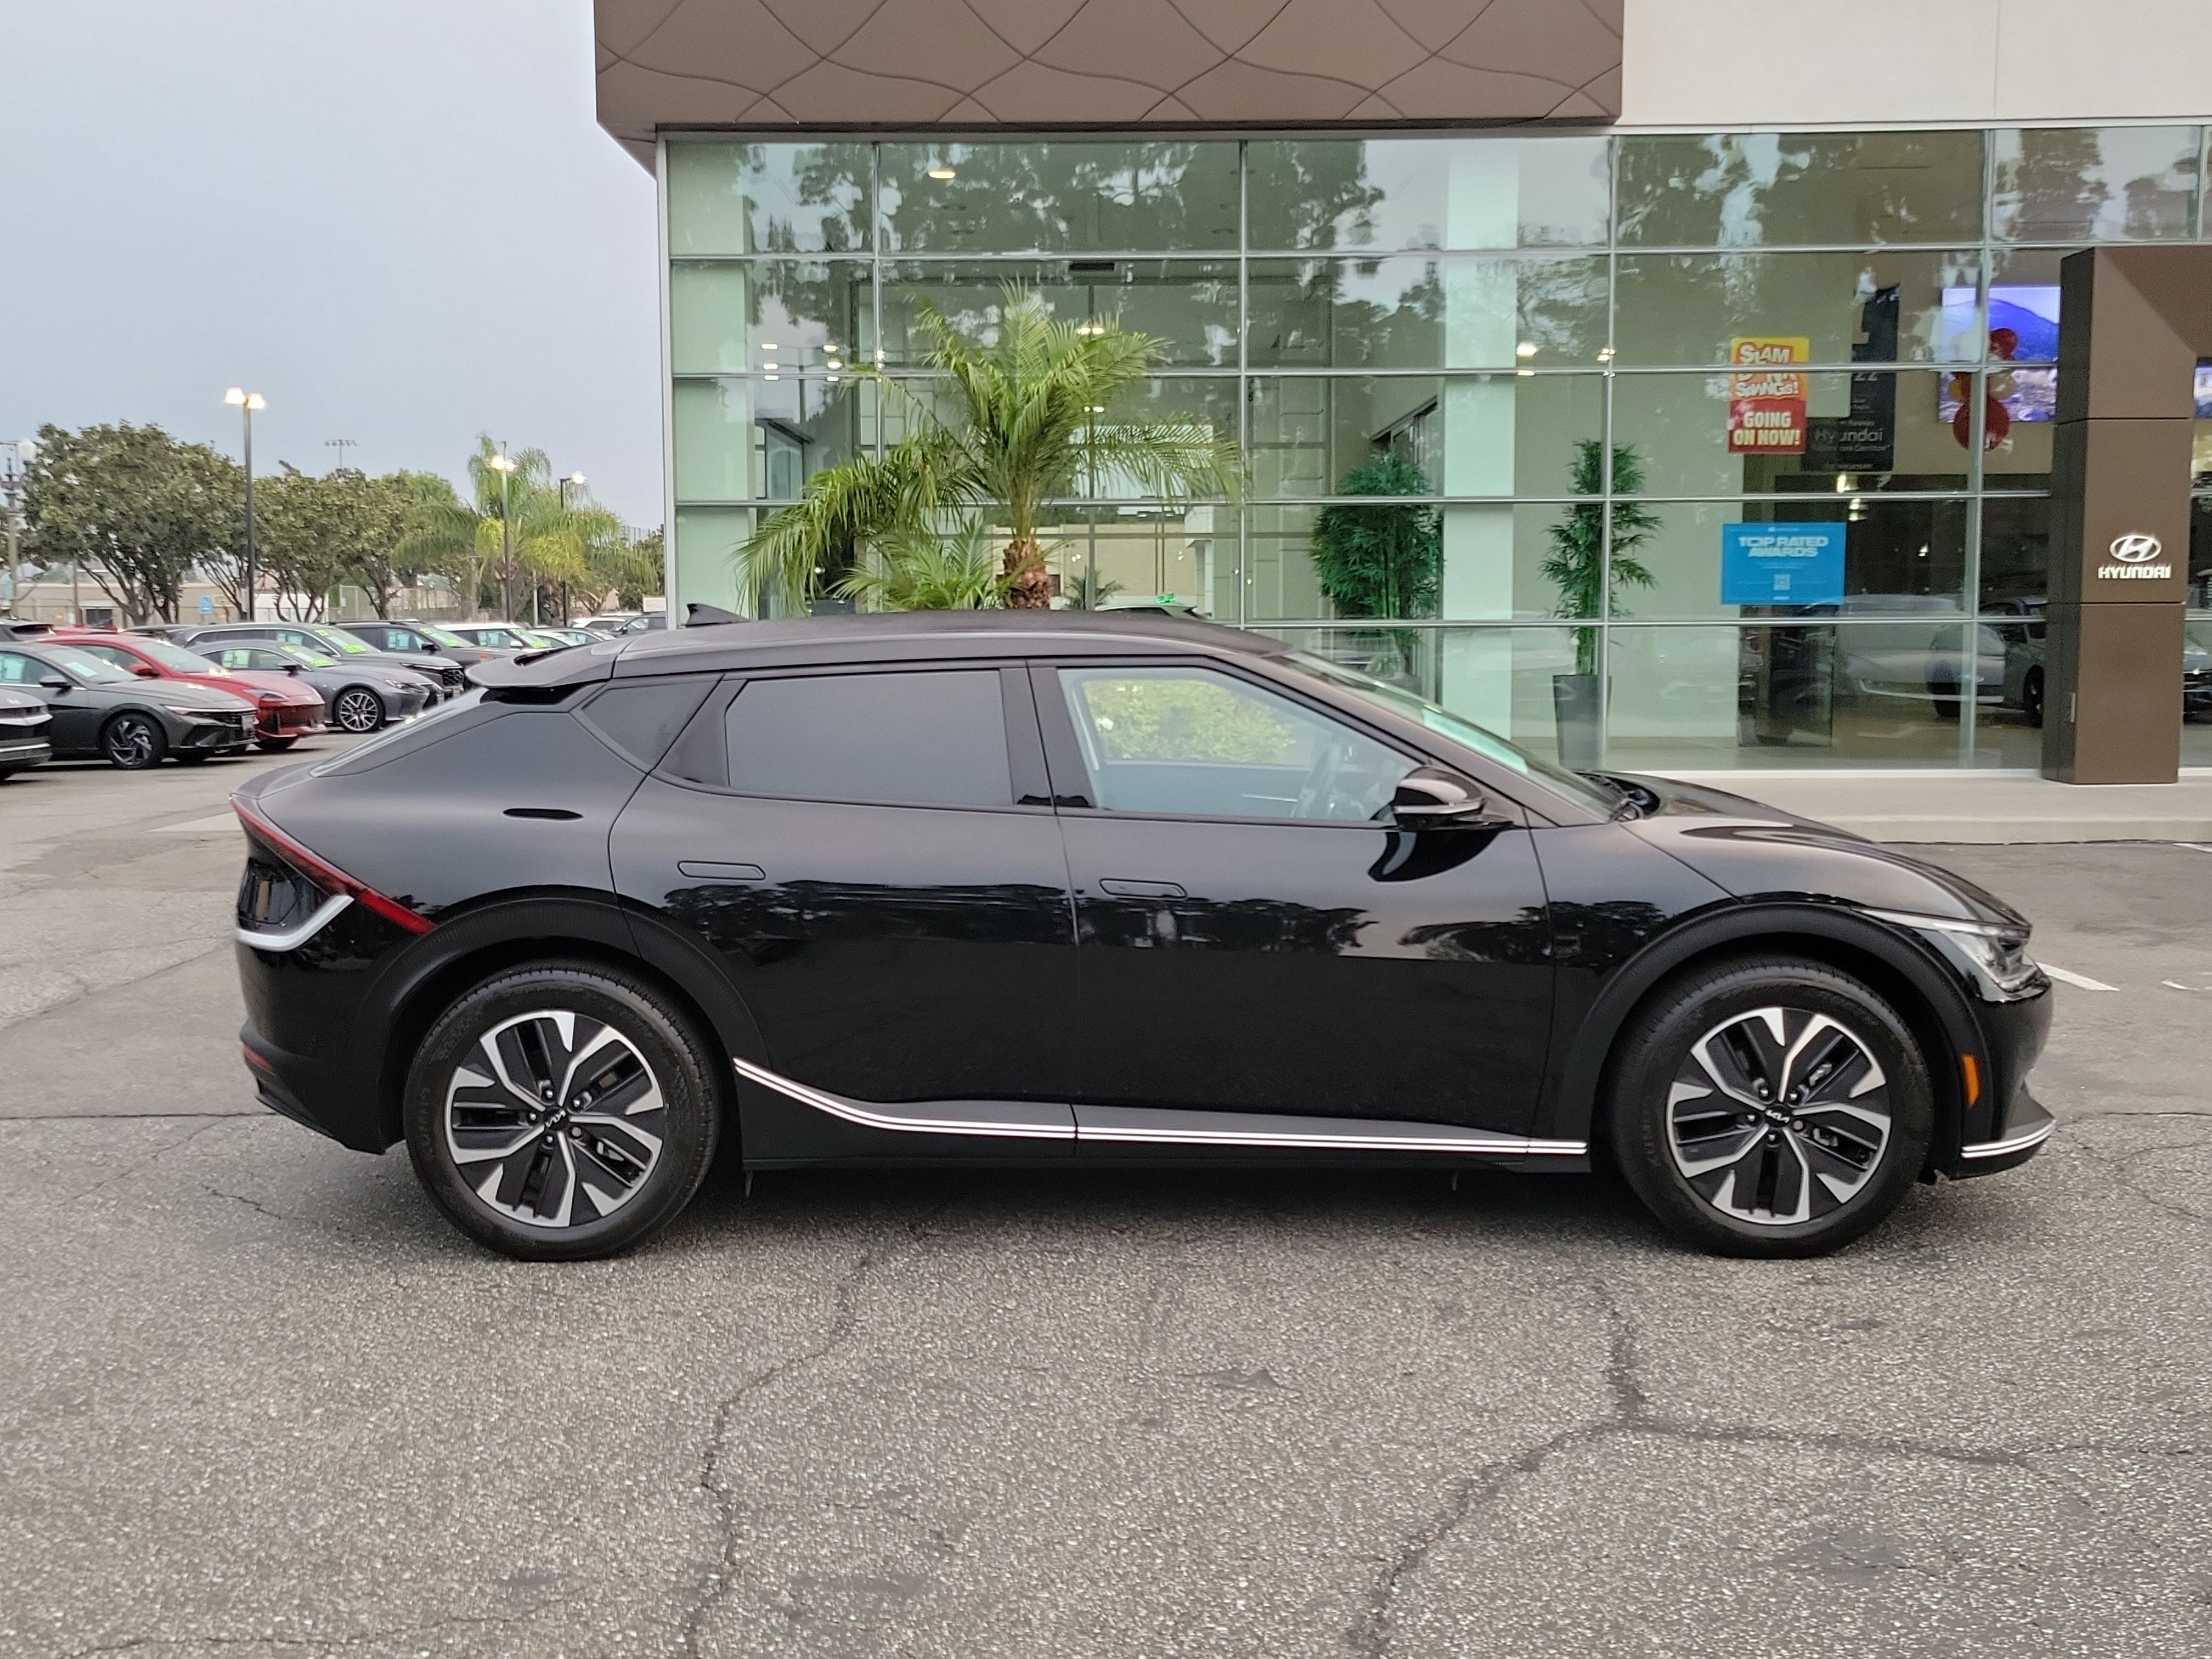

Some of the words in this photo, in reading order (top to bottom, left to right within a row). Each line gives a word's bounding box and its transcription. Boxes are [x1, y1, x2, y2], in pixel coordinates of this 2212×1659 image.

[1739, 345, 1791, 365] SLAM
[1743, 411, 1792, 428] GOING
[1733, 429, 1756, 446] ON
[1757, 429, 1801, 446] NOW!
[1739, 536, 1776, 548] TOP
[1777, 536, 1830, 548] RATED
[1748, 548, 1819, 557] AWARDS
[2098, 564, 2171, 579] HYUNDAI
